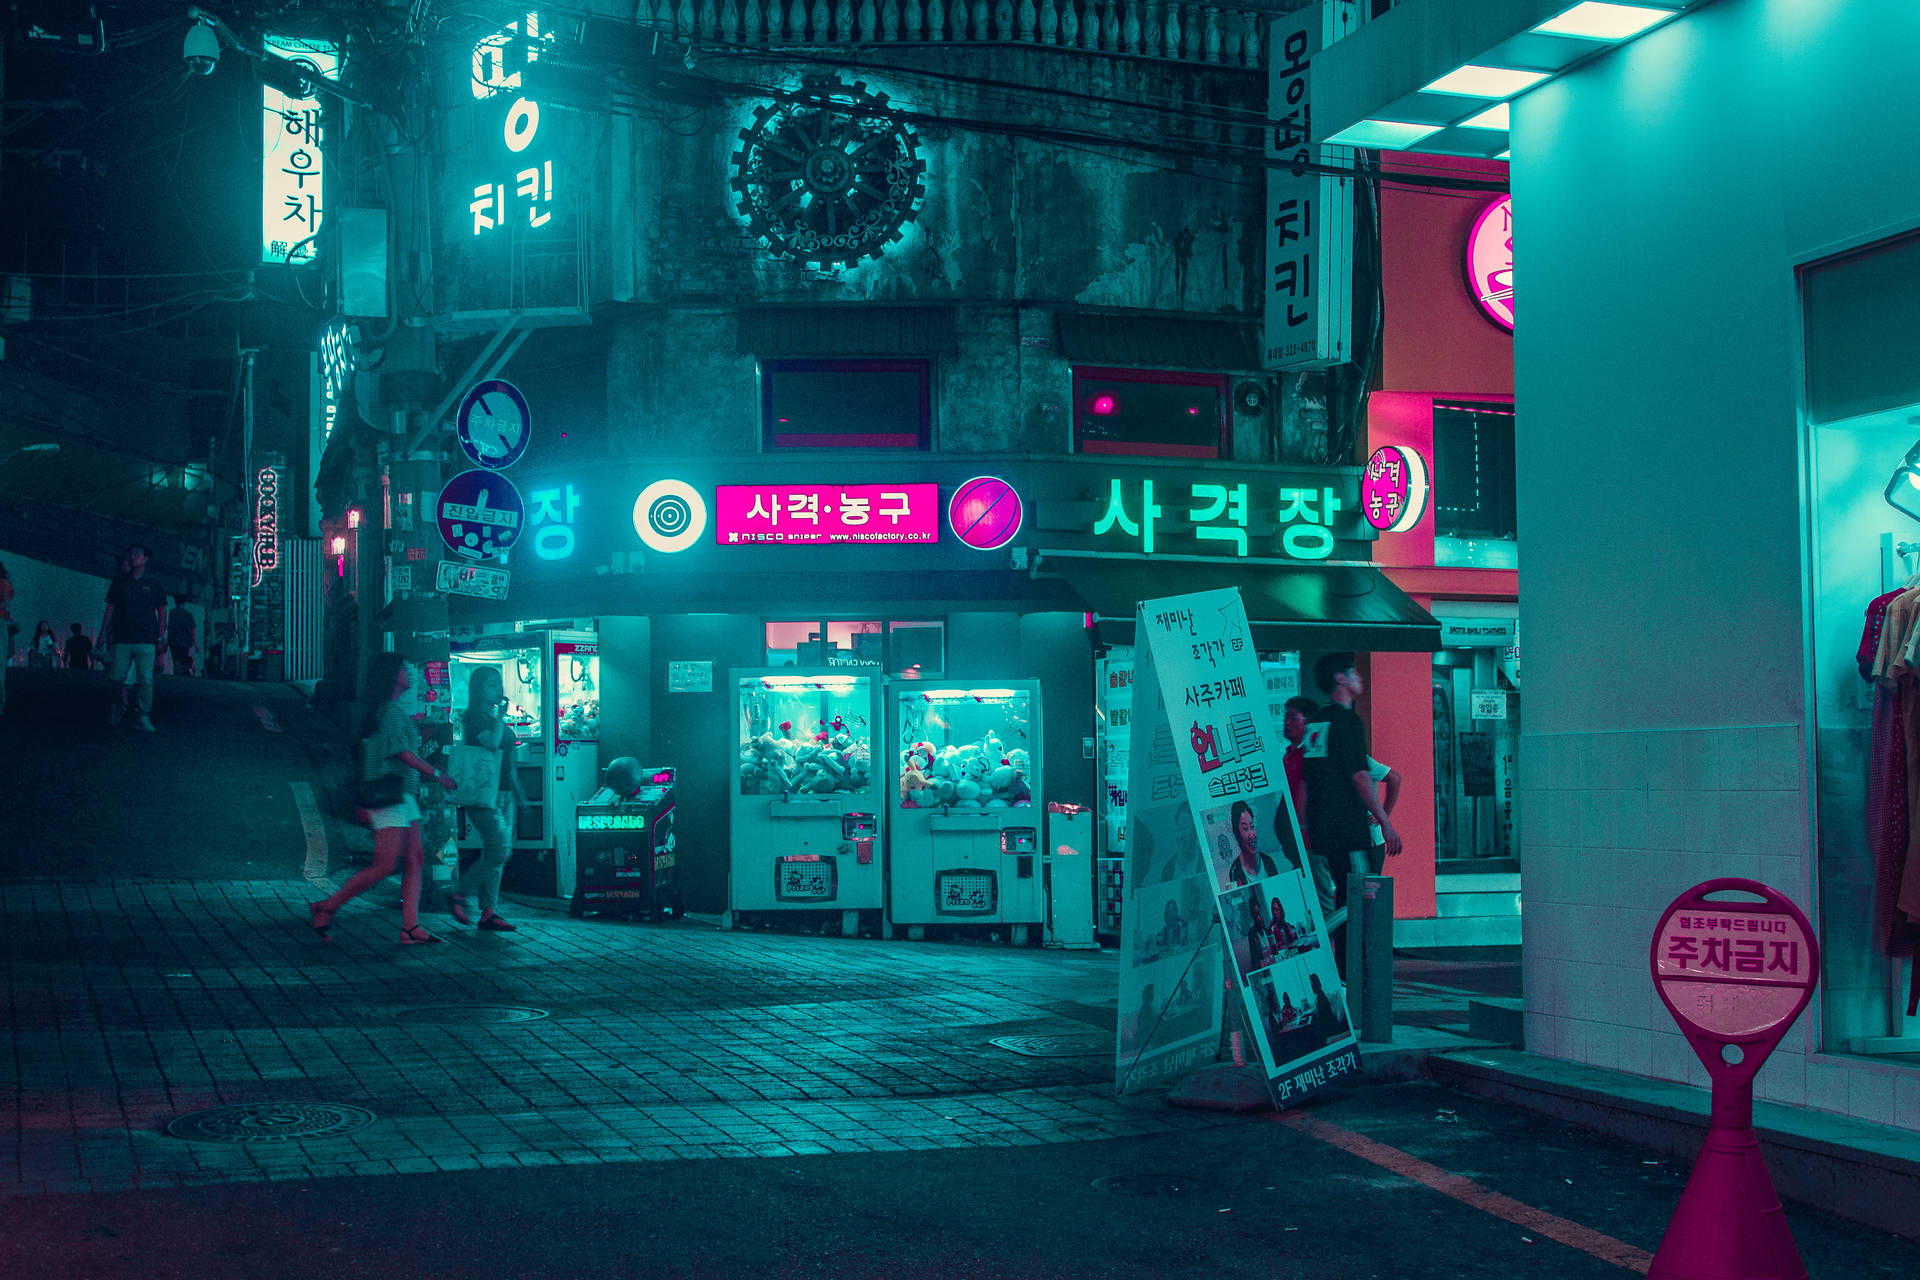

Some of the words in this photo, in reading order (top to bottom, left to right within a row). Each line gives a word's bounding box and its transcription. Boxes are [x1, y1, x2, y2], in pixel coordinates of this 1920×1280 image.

[282, 109, 322, 233] 해우차
[469, 160, 553, 236] 치킨
[1274, 198, 1310, 327] 치킨
[1368, 459, 1402, 489] 사격
[448, 504, 513, 528] 진입금지
[1093, 478, 1342, 560] 사격장
[1368, 489, 1400, 520] 농구
[829, 532, 931, 542] www.niscofactory.co.kr
[1155, 608, 1197, 636] 재미난
[1191, 638, 1225, 669] 조각가
[1185, 675, 1247, 708] 사주카페
[1190, 711, 1265, 774] 언니들의
[1208, 762, 1269, 799] 슬램덩크
[1679, 916, 1787, 935] 협조부탁드립니다
[1668, 935, 1798, 975] 주차금지
[1278, 1079, 1293, 1100] 2F
[1293, 1065, 1328, 1093] 재미난
[1325, 1051, 1358, 1078] 조각가
